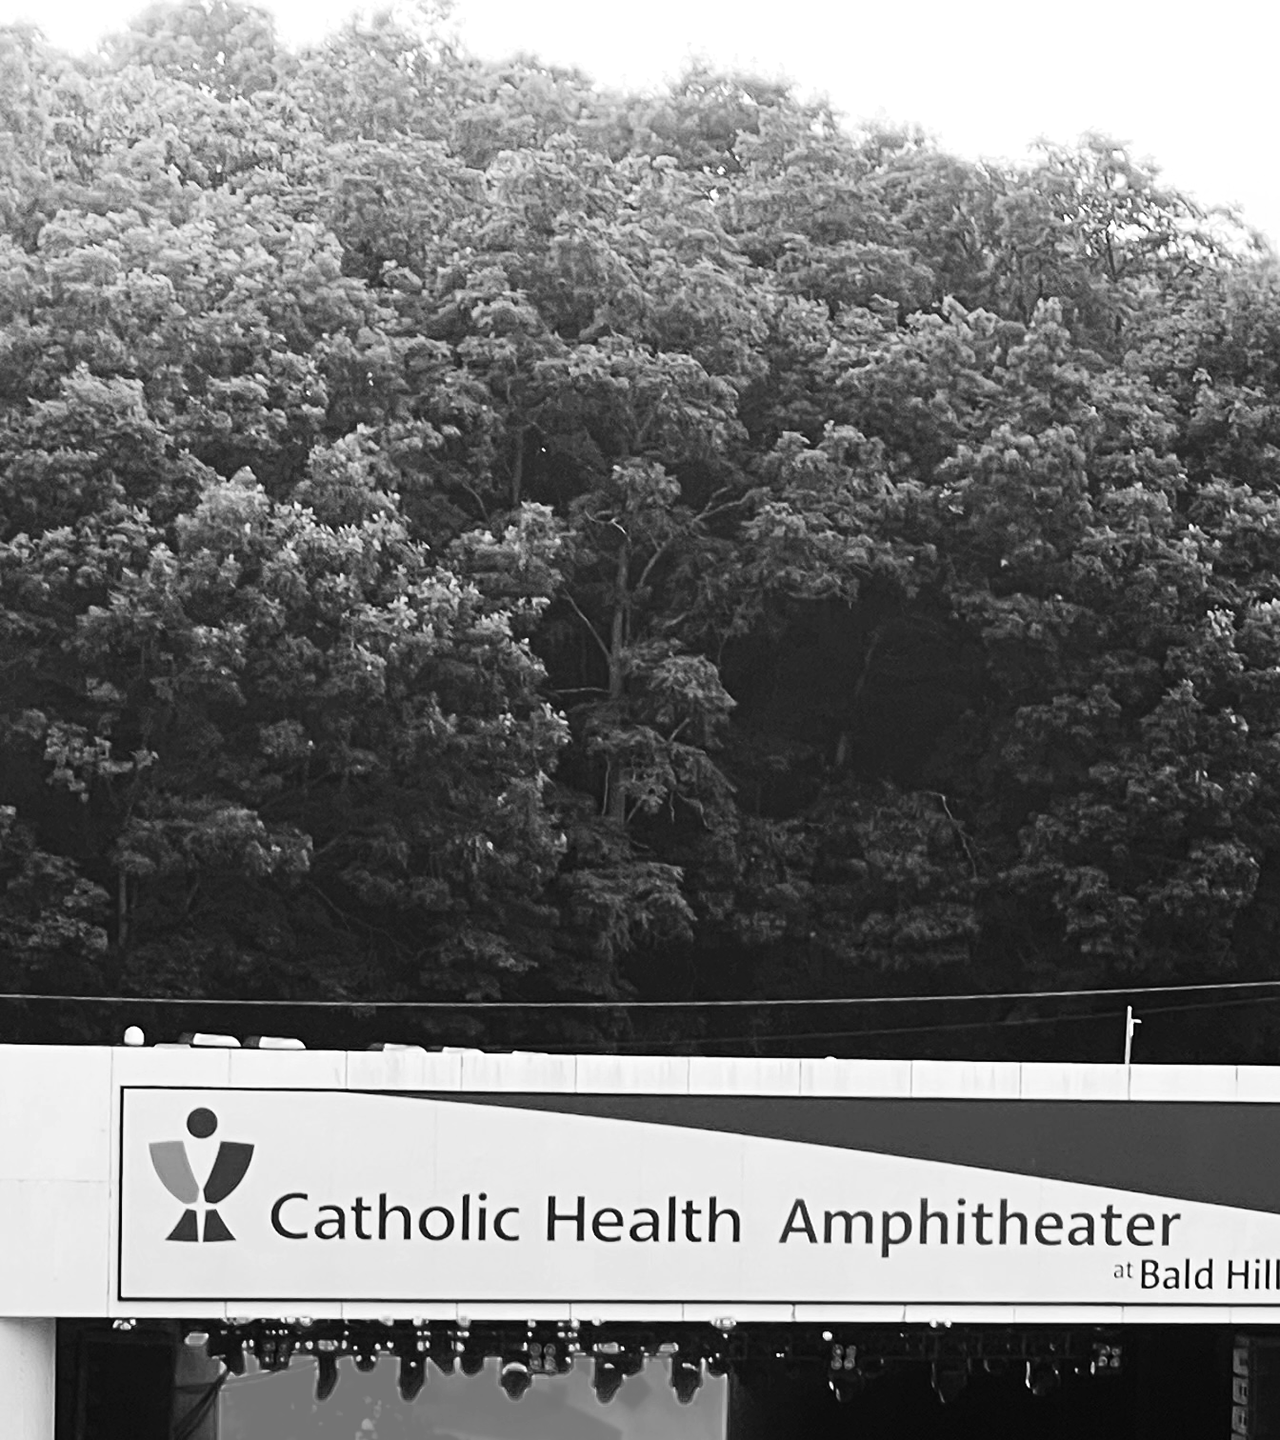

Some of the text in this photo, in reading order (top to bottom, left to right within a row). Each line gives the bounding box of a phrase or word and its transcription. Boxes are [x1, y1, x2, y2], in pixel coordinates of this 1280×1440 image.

[270, 1192, 1181, 1258] Catholic Health Amphitheater
[1113, 1258, 1280, 1291] at Bald Hill
